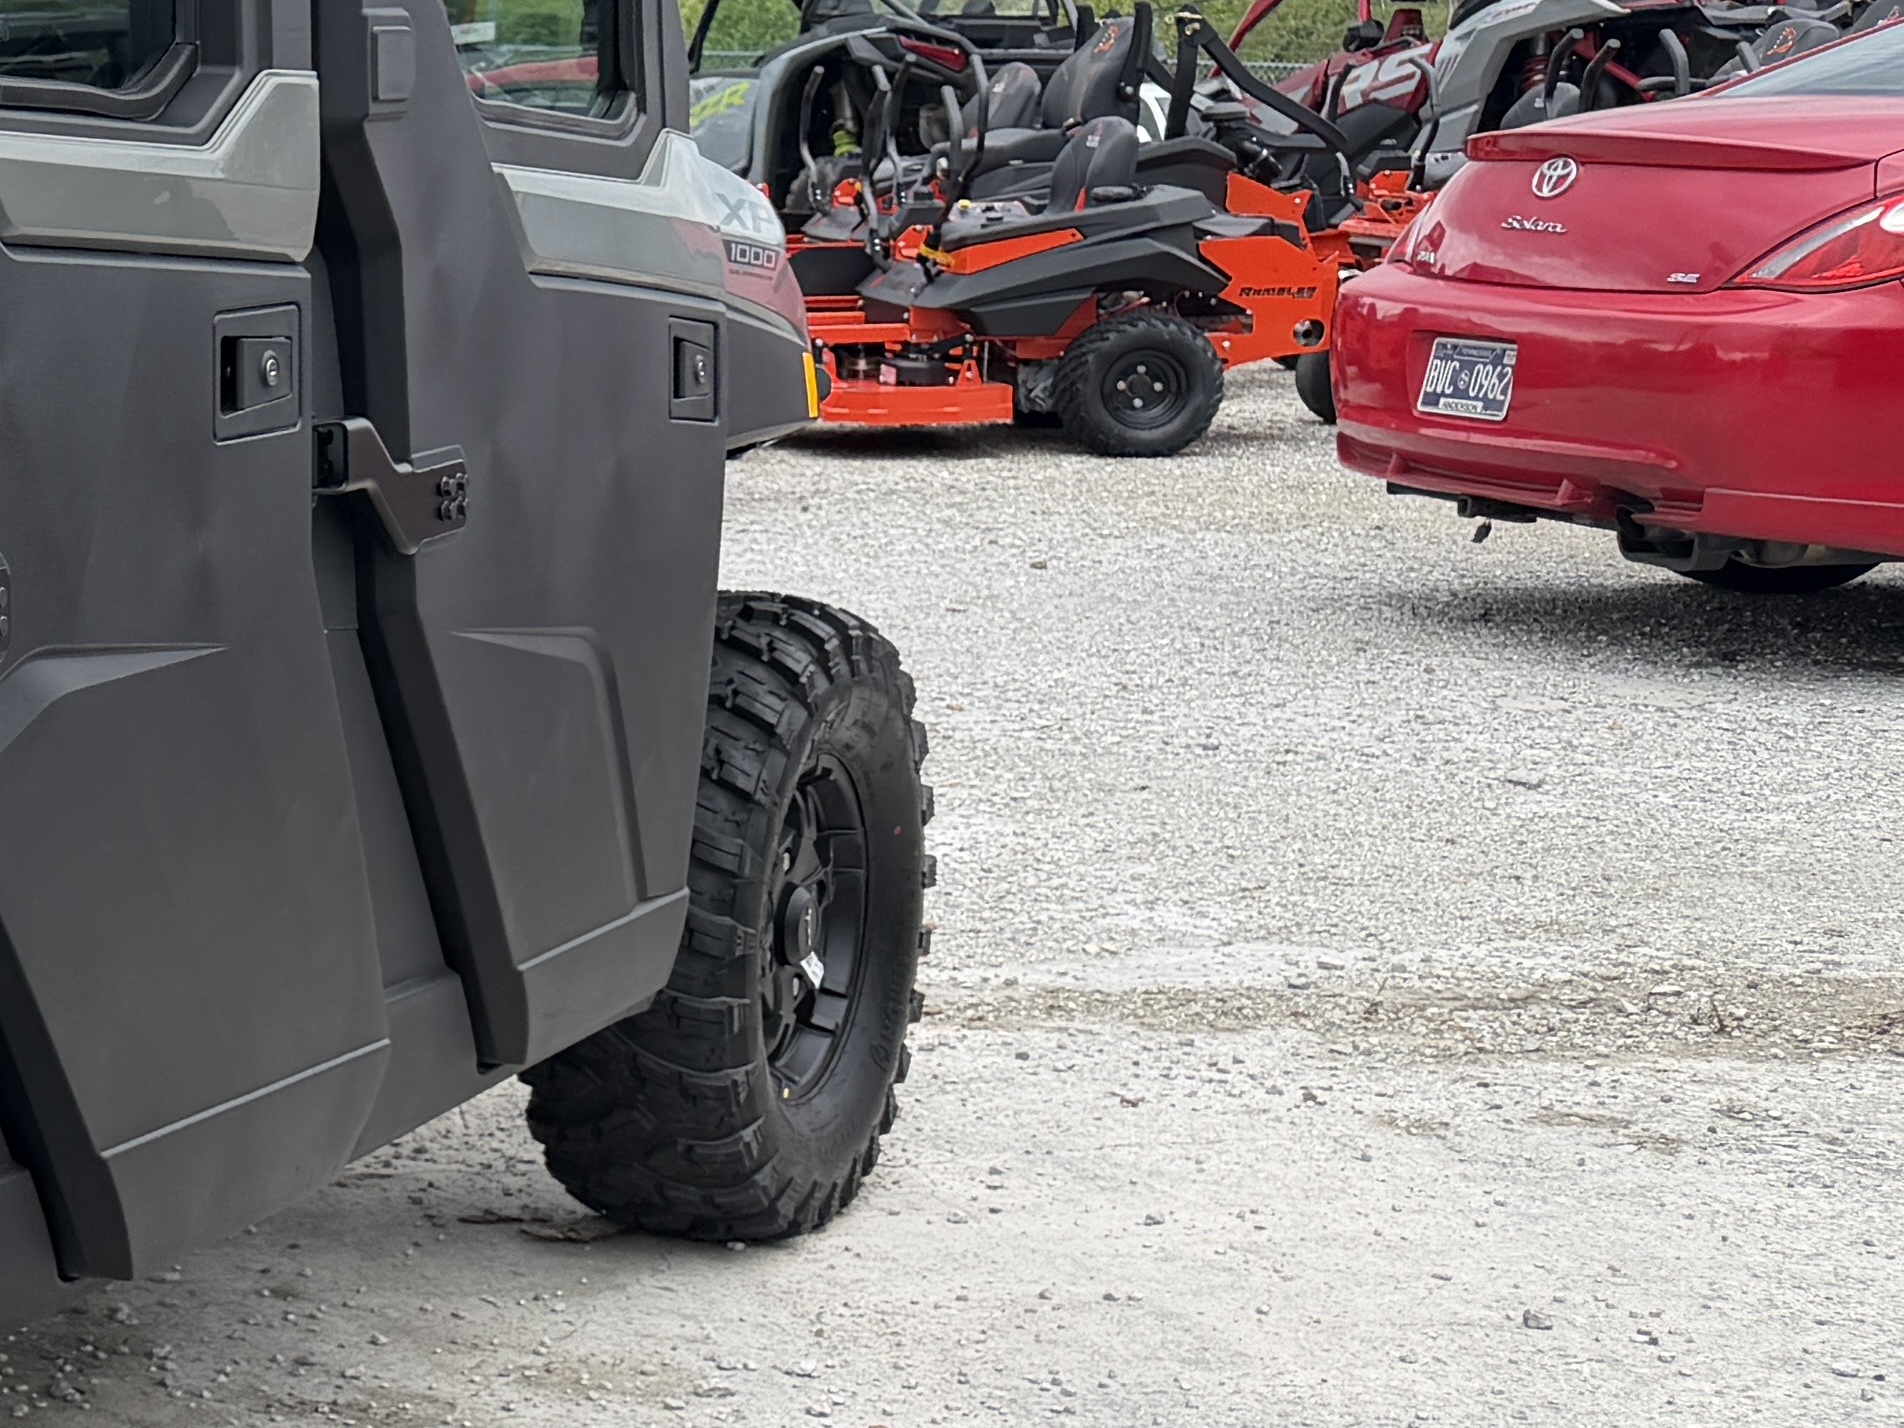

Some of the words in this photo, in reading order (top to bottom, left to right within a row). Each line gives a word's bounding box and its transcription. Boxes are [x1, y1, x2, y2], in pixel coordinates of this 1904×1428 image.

[715, 193, 775, 234] XP
[1500, 215, 1568, 234] Solara
[729, 243, 777, 269] 1000
[1667, 272, 1701, 284] SE
[1426, 359, 1460, 394] BVC
[1468, 364, 1513, 400] 0962
